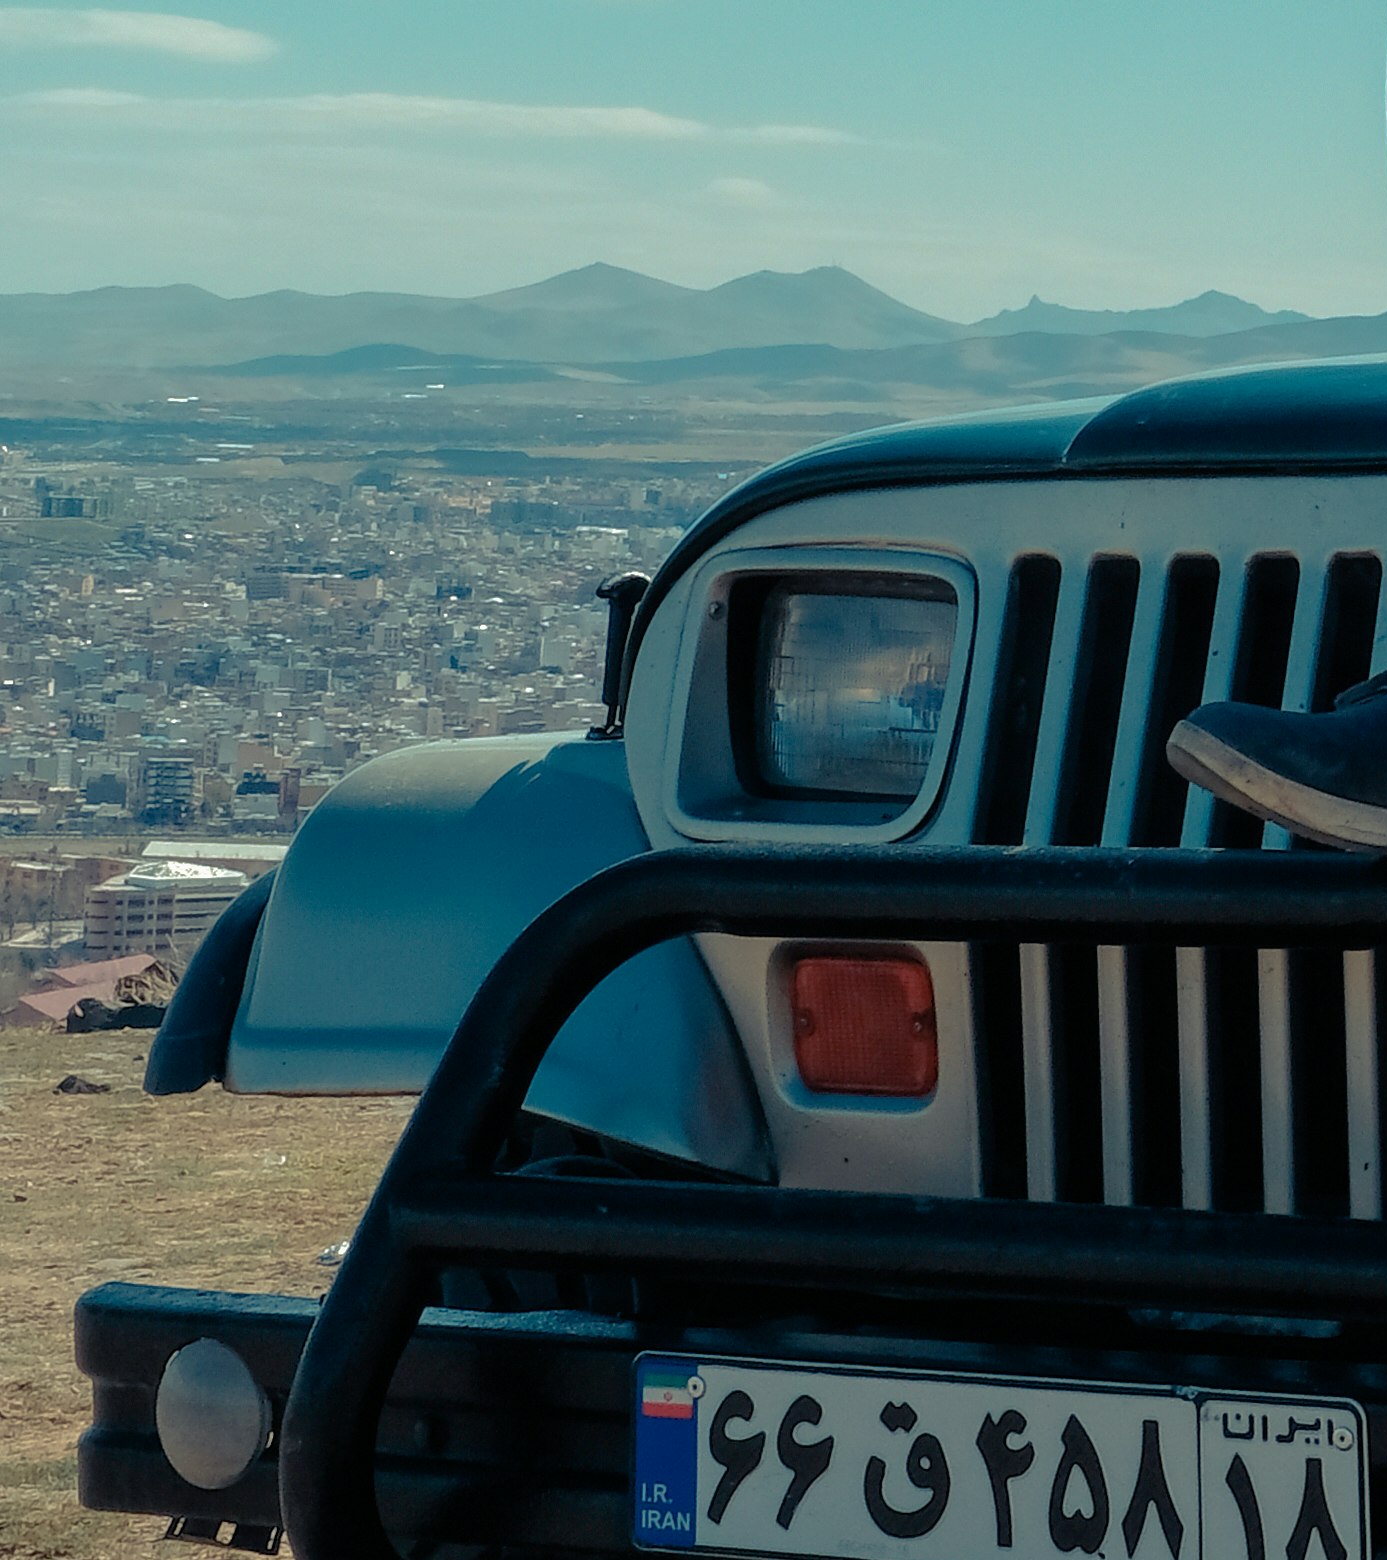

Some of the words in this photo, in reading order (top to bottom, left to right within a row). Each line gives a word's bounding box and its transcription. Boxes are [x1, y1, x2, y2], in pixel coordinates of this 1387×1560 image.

[1222, 1413, 1334, 1446] ایران
[641, 1482, 673, 1504] I.R.
[641, 1509, 691, 1532] IRAN
